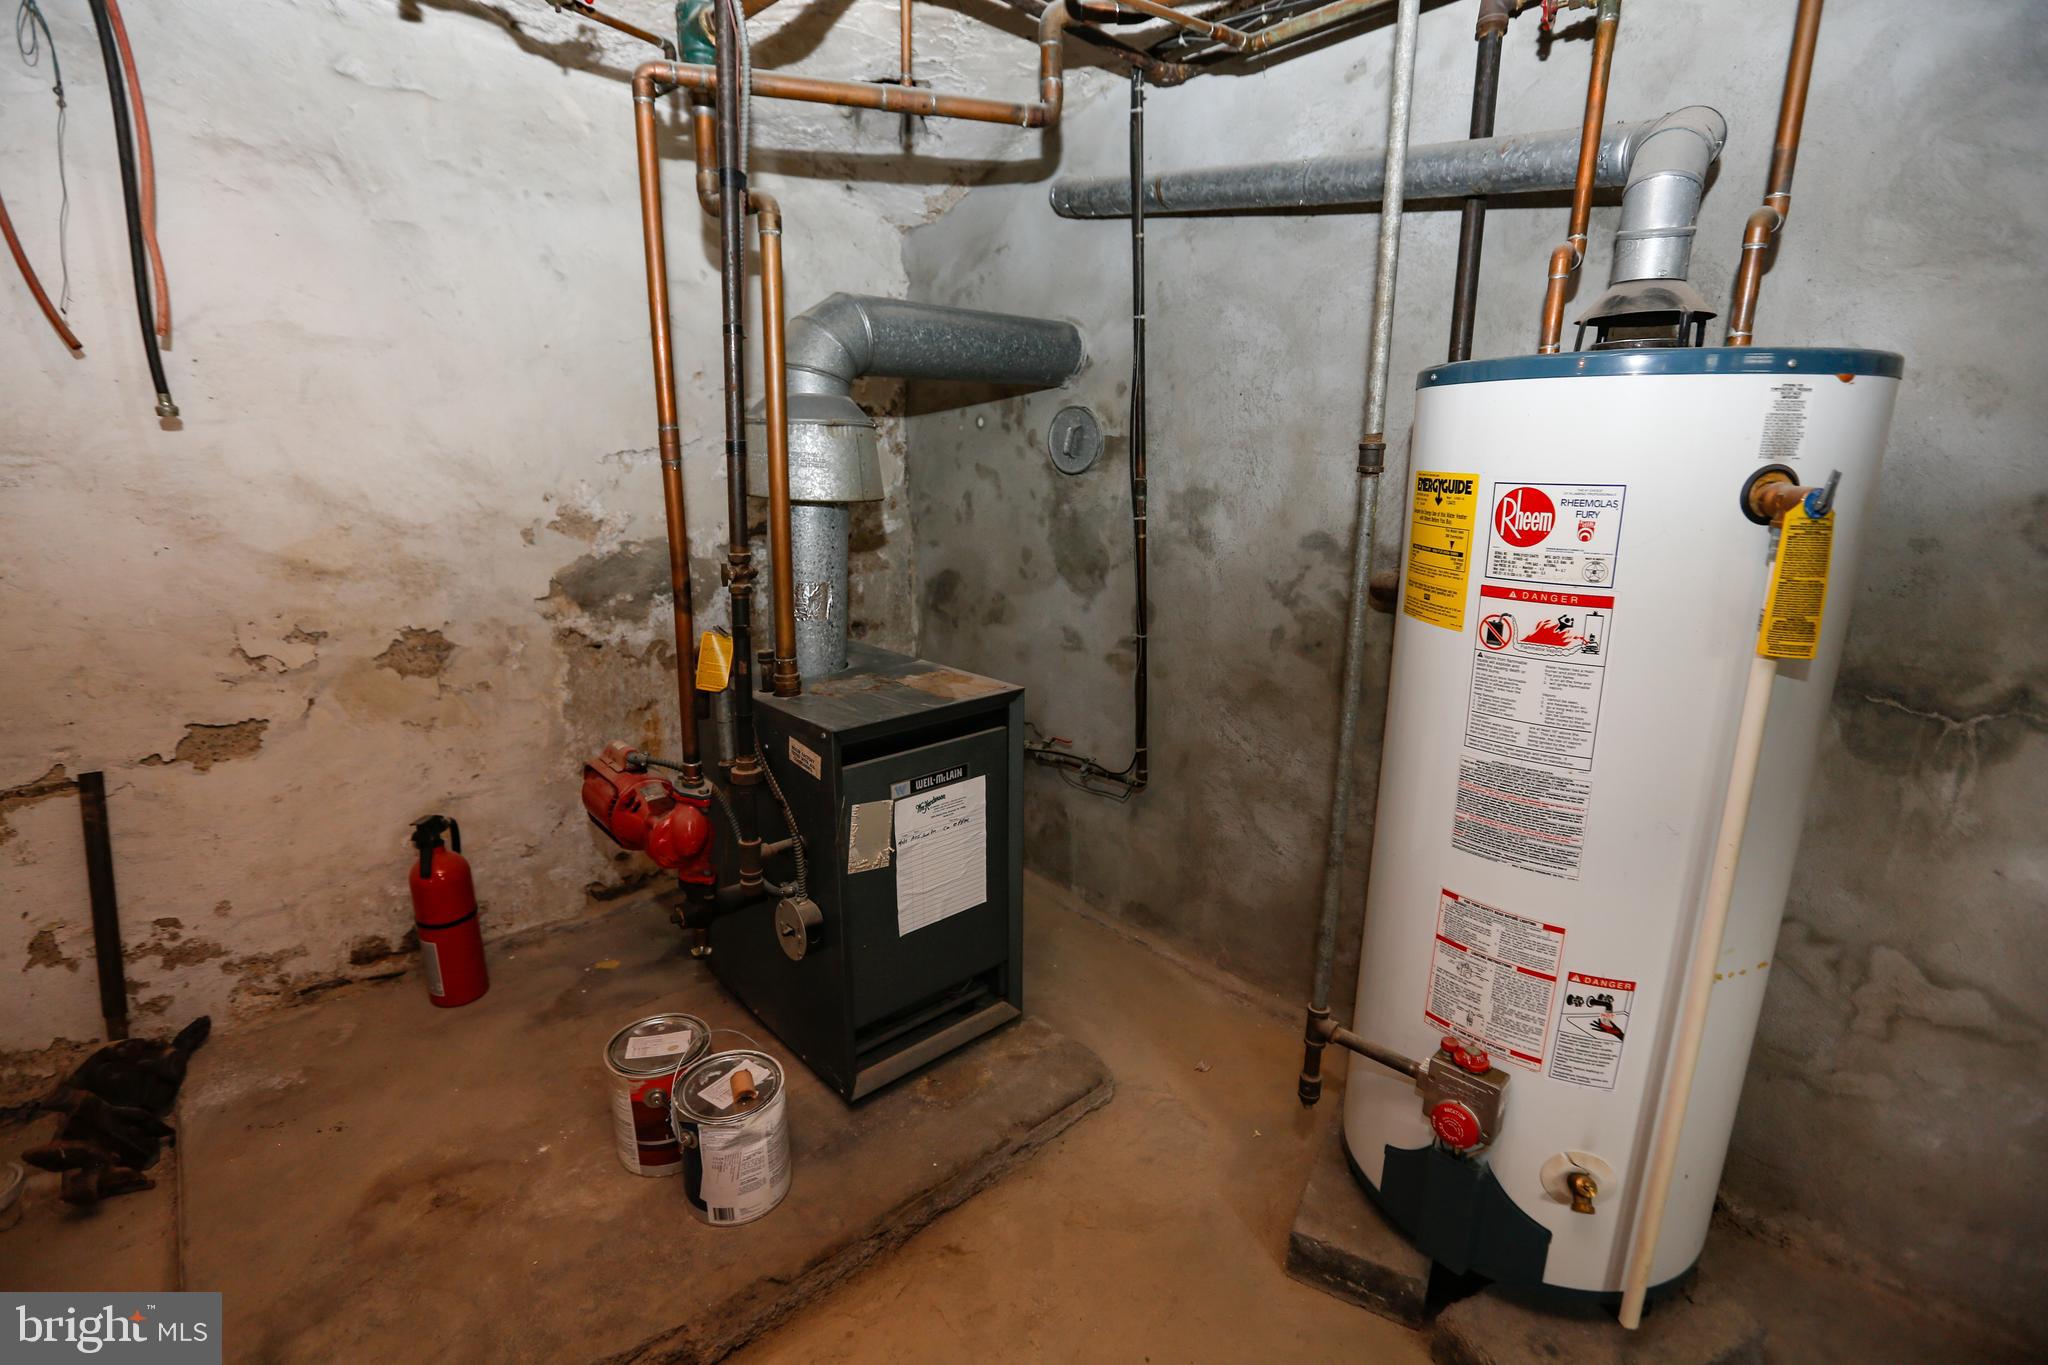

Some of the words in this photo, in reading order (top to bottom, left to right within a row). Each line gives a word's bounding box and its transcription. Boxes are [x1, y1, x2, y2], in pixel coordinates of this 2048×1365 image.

[1560, 498, 1619, 509] RHEEMGLAS
[1500, 489, 1552, 539] Rheem
[1575, 510, 1600, 519] FURY
[1522, 591, 1579, 604] DANGER
[1584, 976, 1633, 990] DANGER
